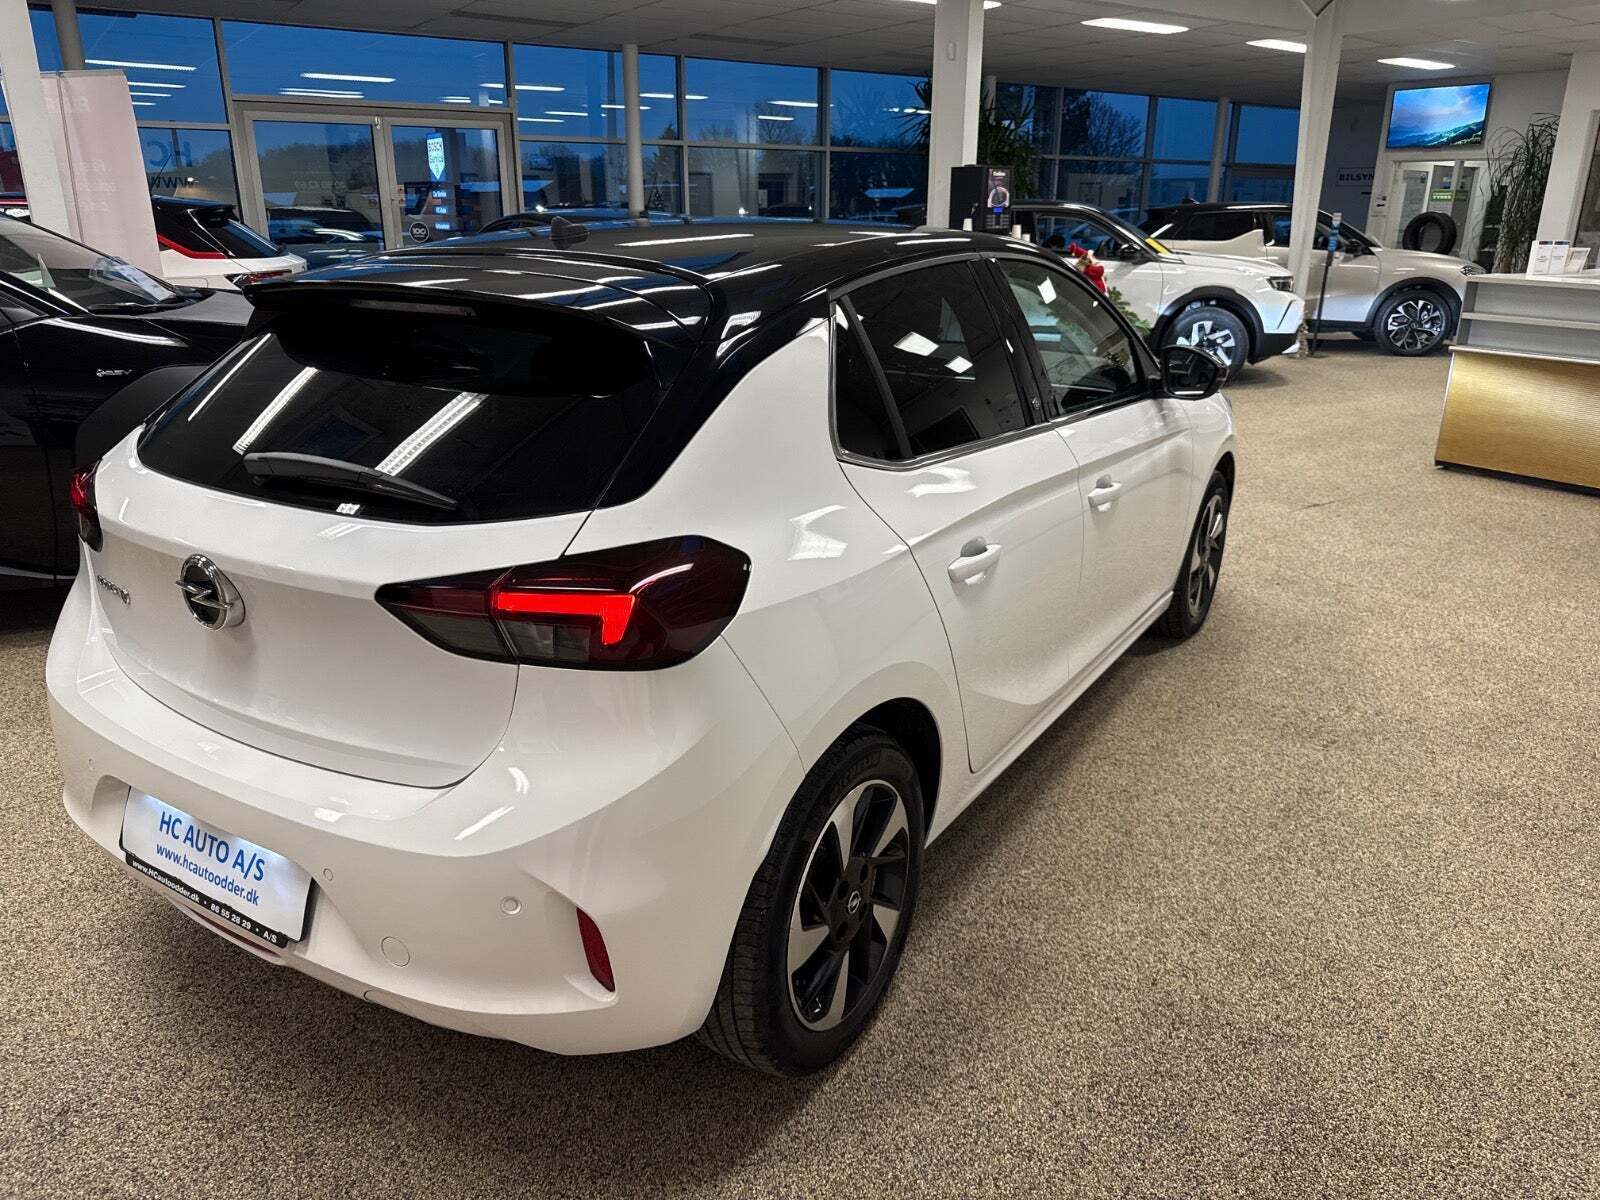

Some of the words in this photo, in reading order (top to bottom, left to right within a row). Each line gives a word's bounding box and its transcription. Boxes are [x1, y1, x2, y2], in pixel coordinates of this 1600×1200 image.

[156, 843, 260, 907] www.hcautoodder.dk
[159, 811, 182, 839] HC
[183, 825, 229, 863] AUTO
[232, 849, 265, 882] A/S
[132, 861, 201, 903] www.HCautoodder.dk
[210, 903, 220, 914] 86
[221, 908, 231, 919] 55
[231, 913, 241, 924] 28
[241, 918, 252, 930] 29
[263, 930, 278, 943] A/S
